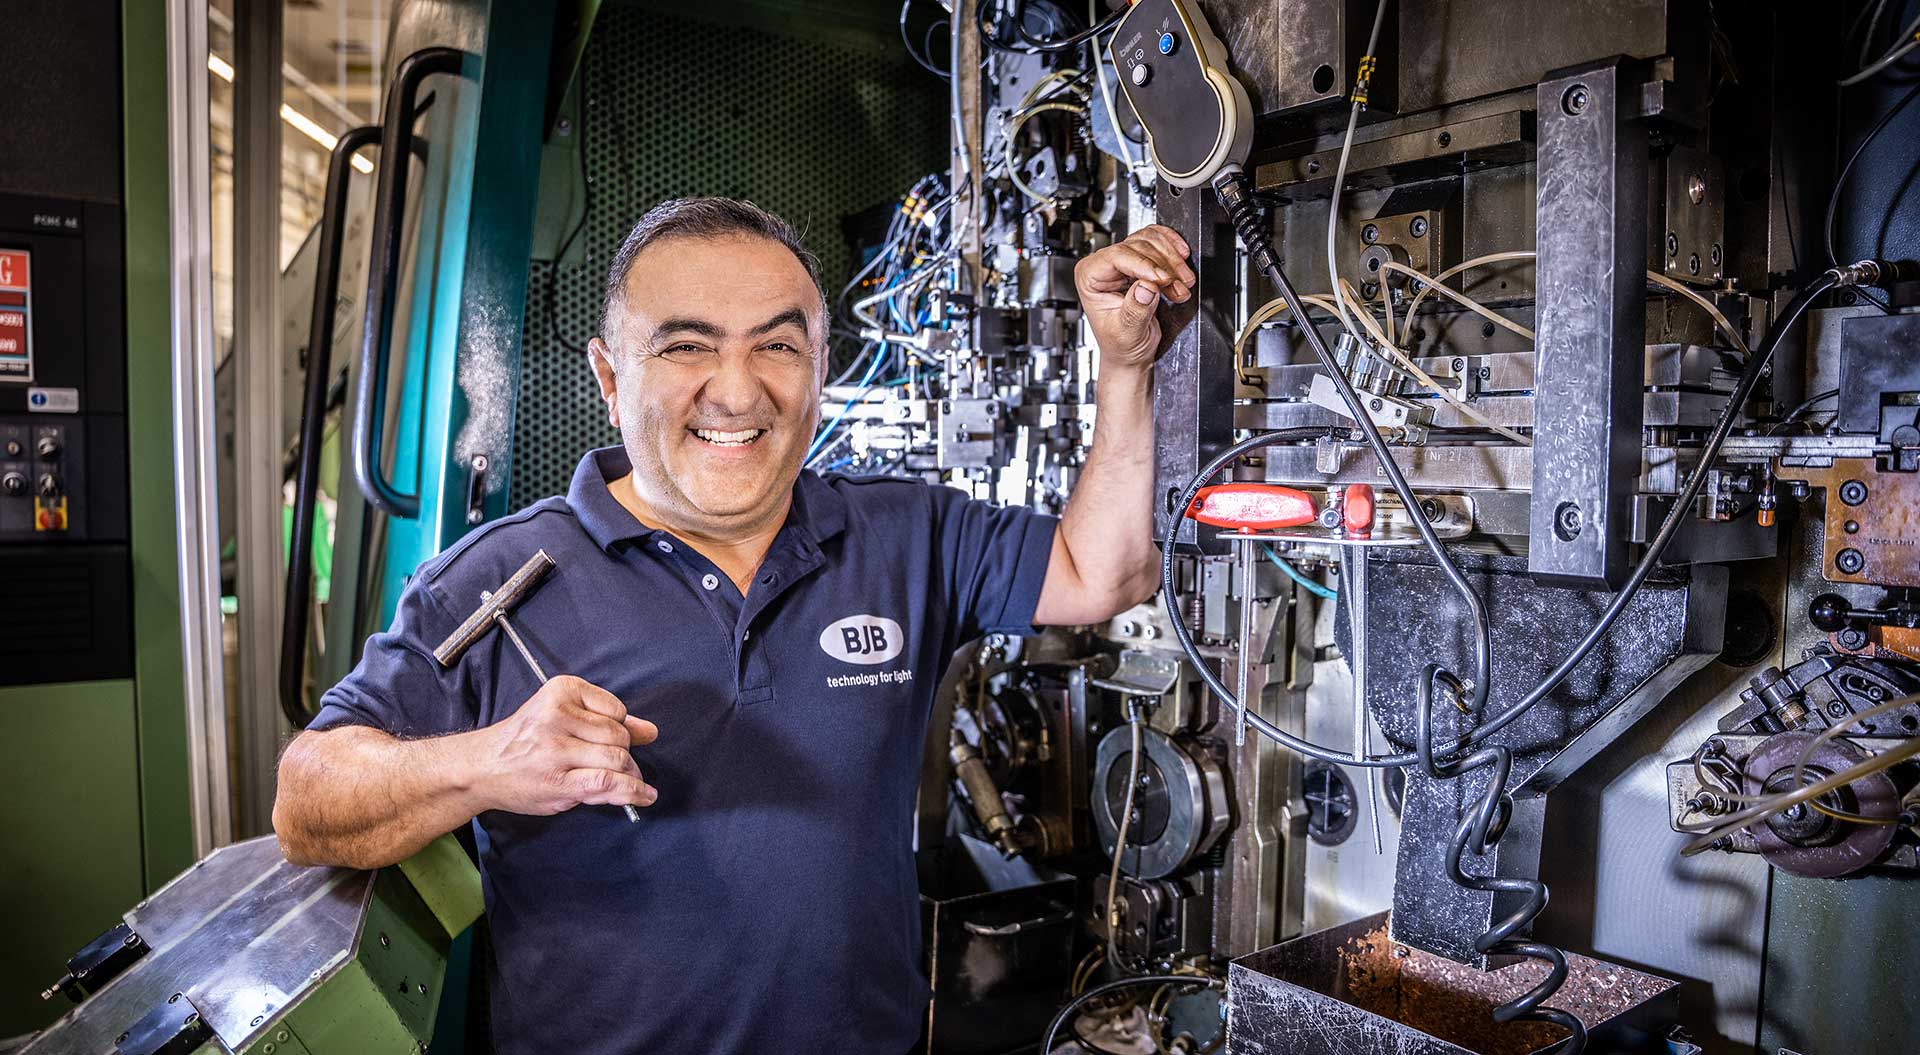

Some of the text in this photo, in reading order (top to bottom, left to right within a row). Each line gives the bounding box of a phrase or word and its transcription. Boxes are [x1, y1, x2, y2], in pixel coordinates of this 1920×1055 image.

[841, 625, 888, 655] BJB
[827, 669, 913, 688] technology for light
